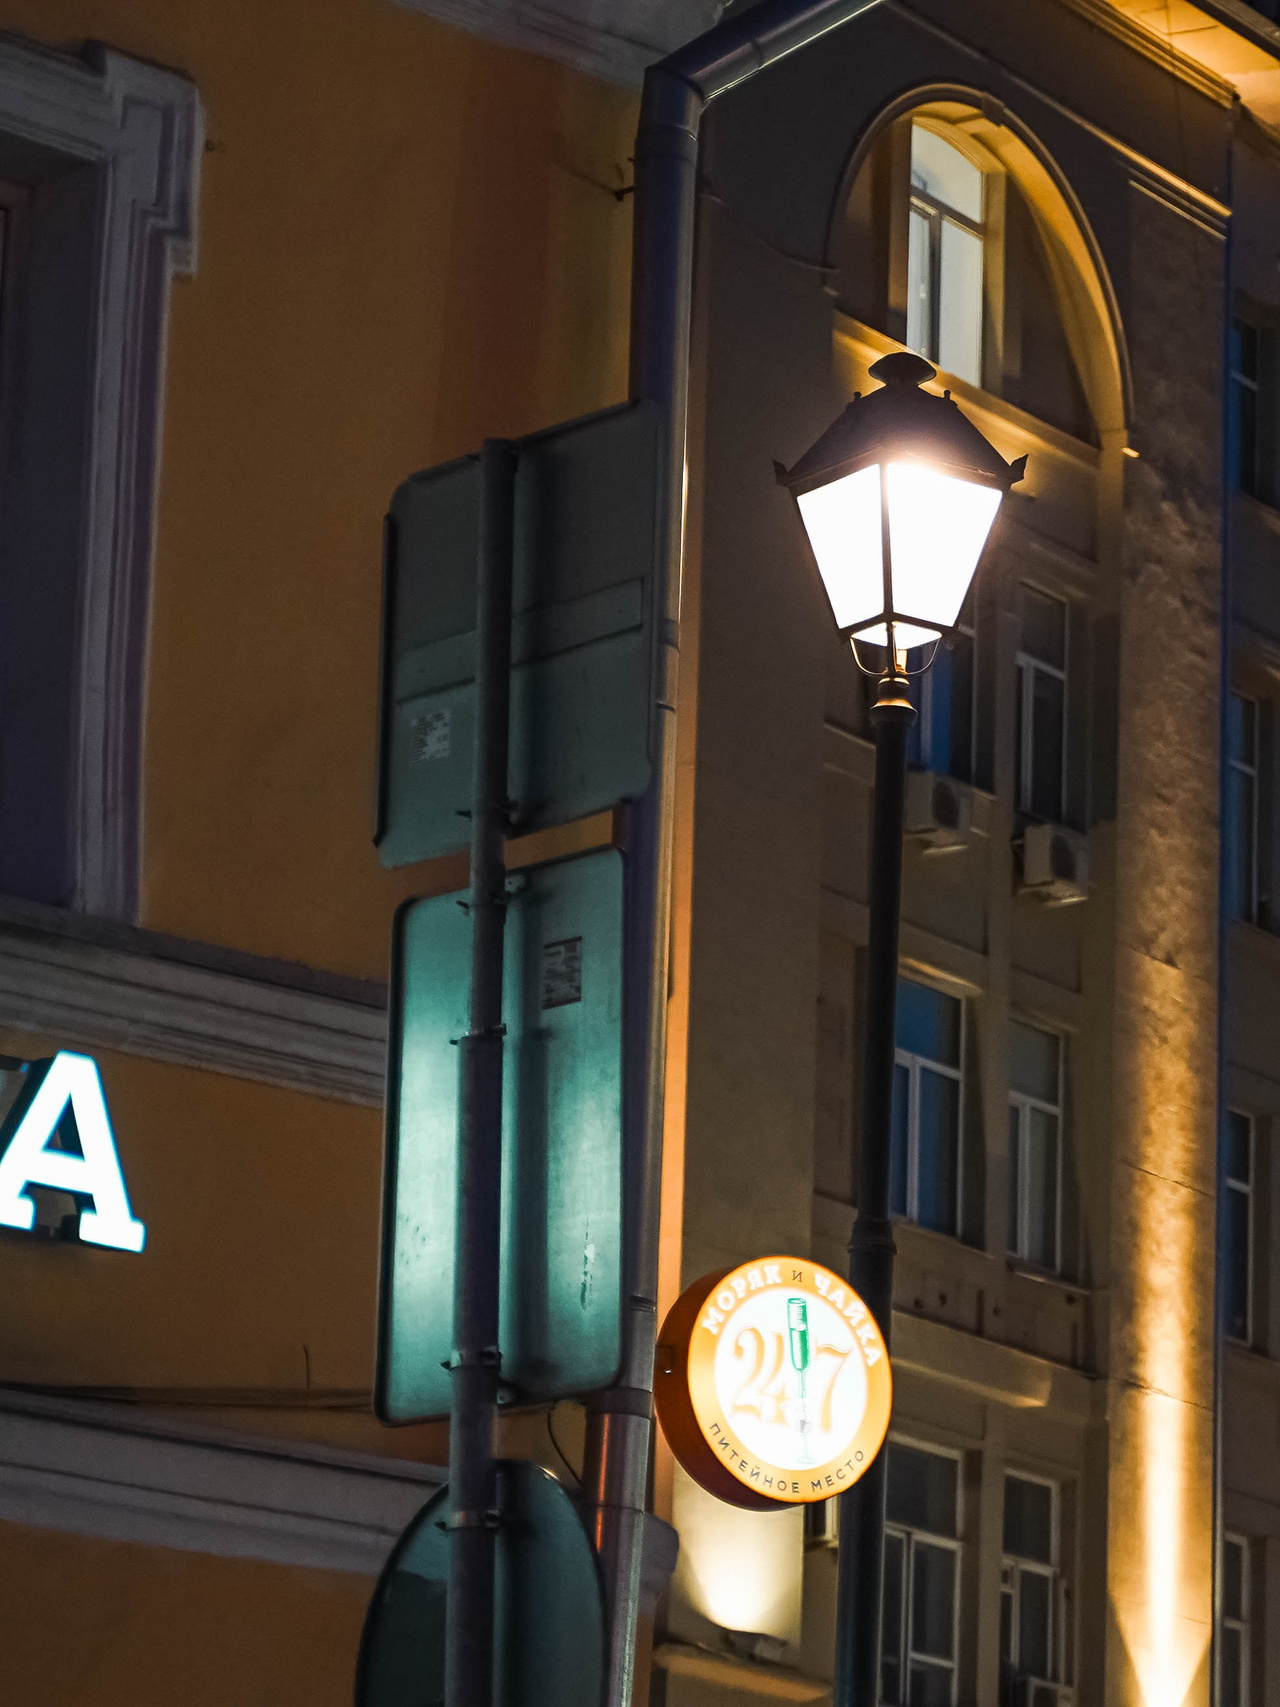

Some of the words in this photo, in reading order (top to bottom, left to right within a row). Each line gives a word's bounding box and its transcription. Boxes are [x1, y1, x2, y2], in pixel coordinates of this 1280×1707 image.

[702, 1265, 782, 1335] МОРЯК
[814, 1273, 882, 1367] ЧАЙКА
[709, 1422, 800, 1493] ПИТЕЙНОЕ
[811, 1449, 864, 1492] МЕСТО
